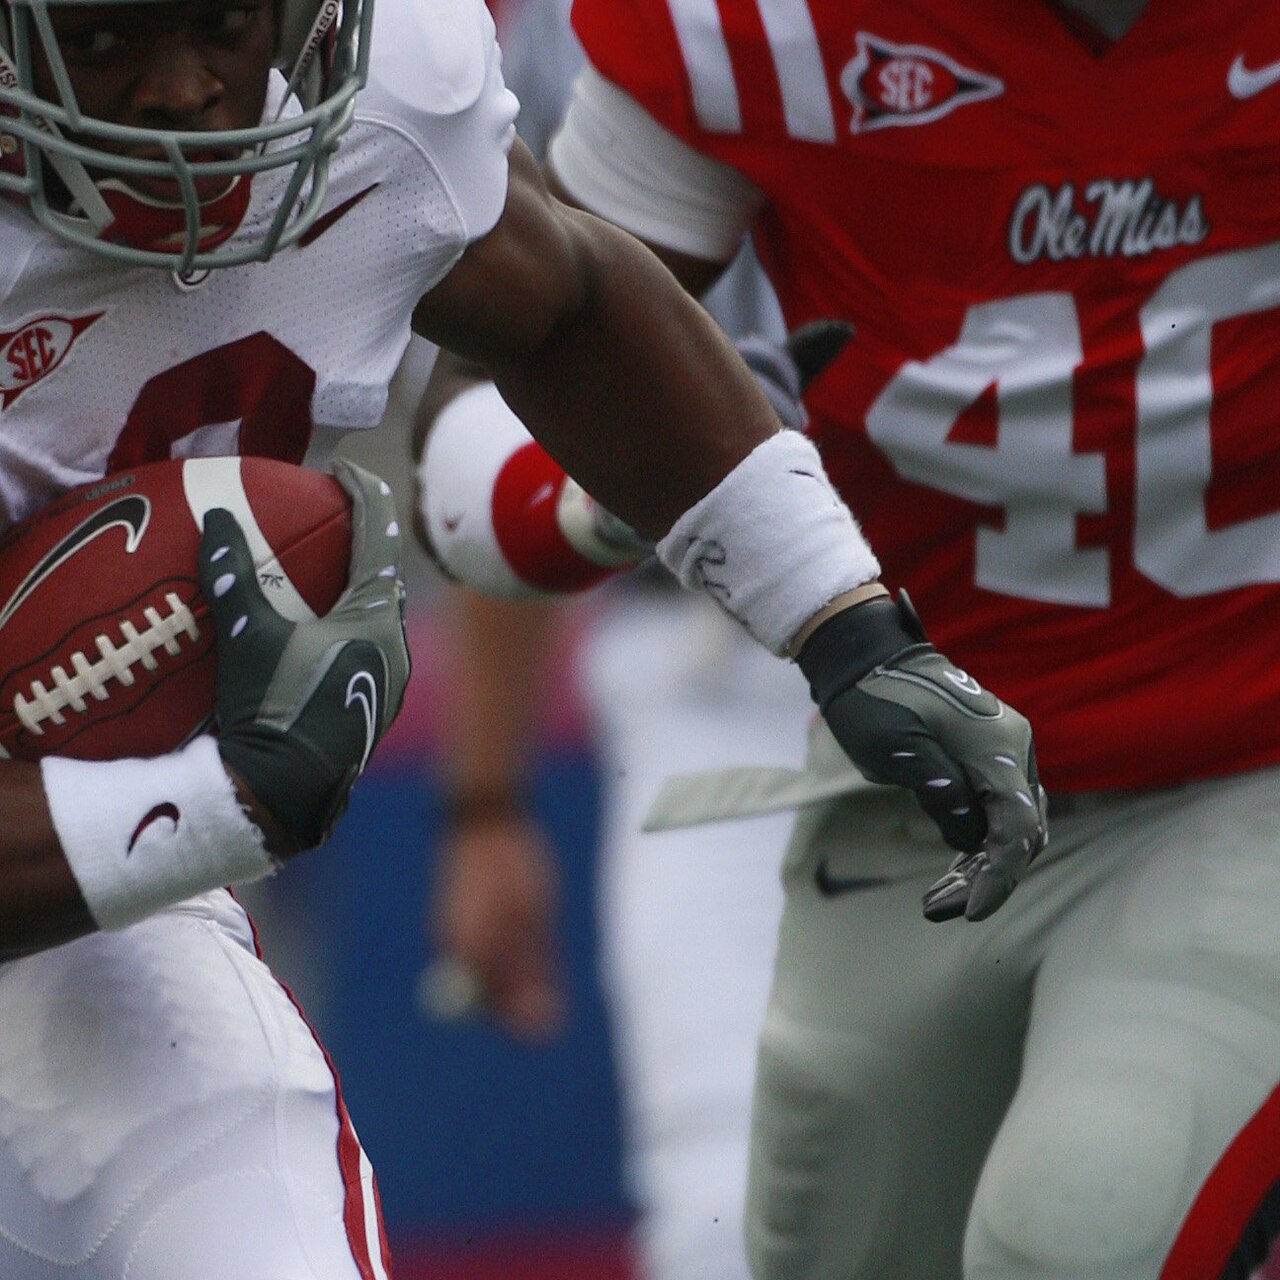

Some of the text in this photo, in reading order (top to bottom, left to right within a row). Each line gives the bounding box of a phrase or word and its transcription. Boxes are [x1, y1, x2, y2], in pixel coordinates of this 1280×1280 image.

[879, 59, 934, 111] SEC
[1010, 177, 1208, 265] Ole Miss
[6, 328, 55, 381] SEC
